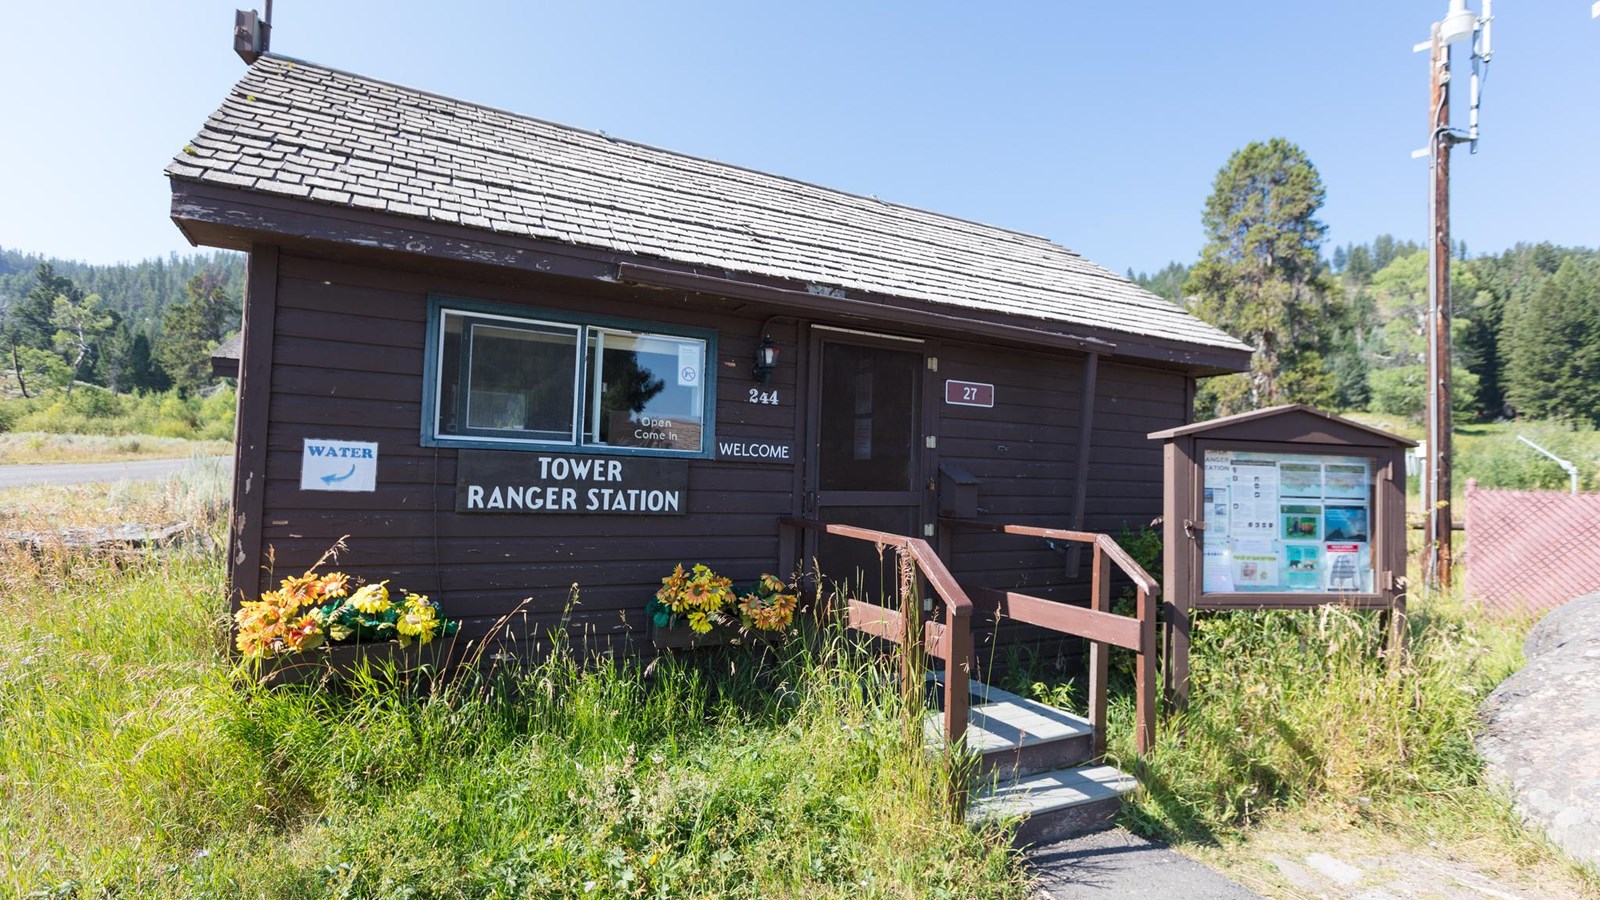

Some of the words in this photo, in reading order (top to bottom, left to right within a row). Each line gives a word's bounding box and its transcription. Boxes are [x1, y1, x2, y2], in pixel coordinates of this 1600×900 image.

[748, 388, 779, 405] 244
[963, 386, 977, 400] 27
[641, 417, 672, 428] Open
[634, 429, 666, 439] Come
[669, 431, 678, 441] In
[307, 445, 374, 459] WATER
[719, 442, 789, 459] WELCOME
[538, 456, 622, 482] TOWER
[467, 485, 577, 510] RANGER
[586, 488, 679, 512] STATION
